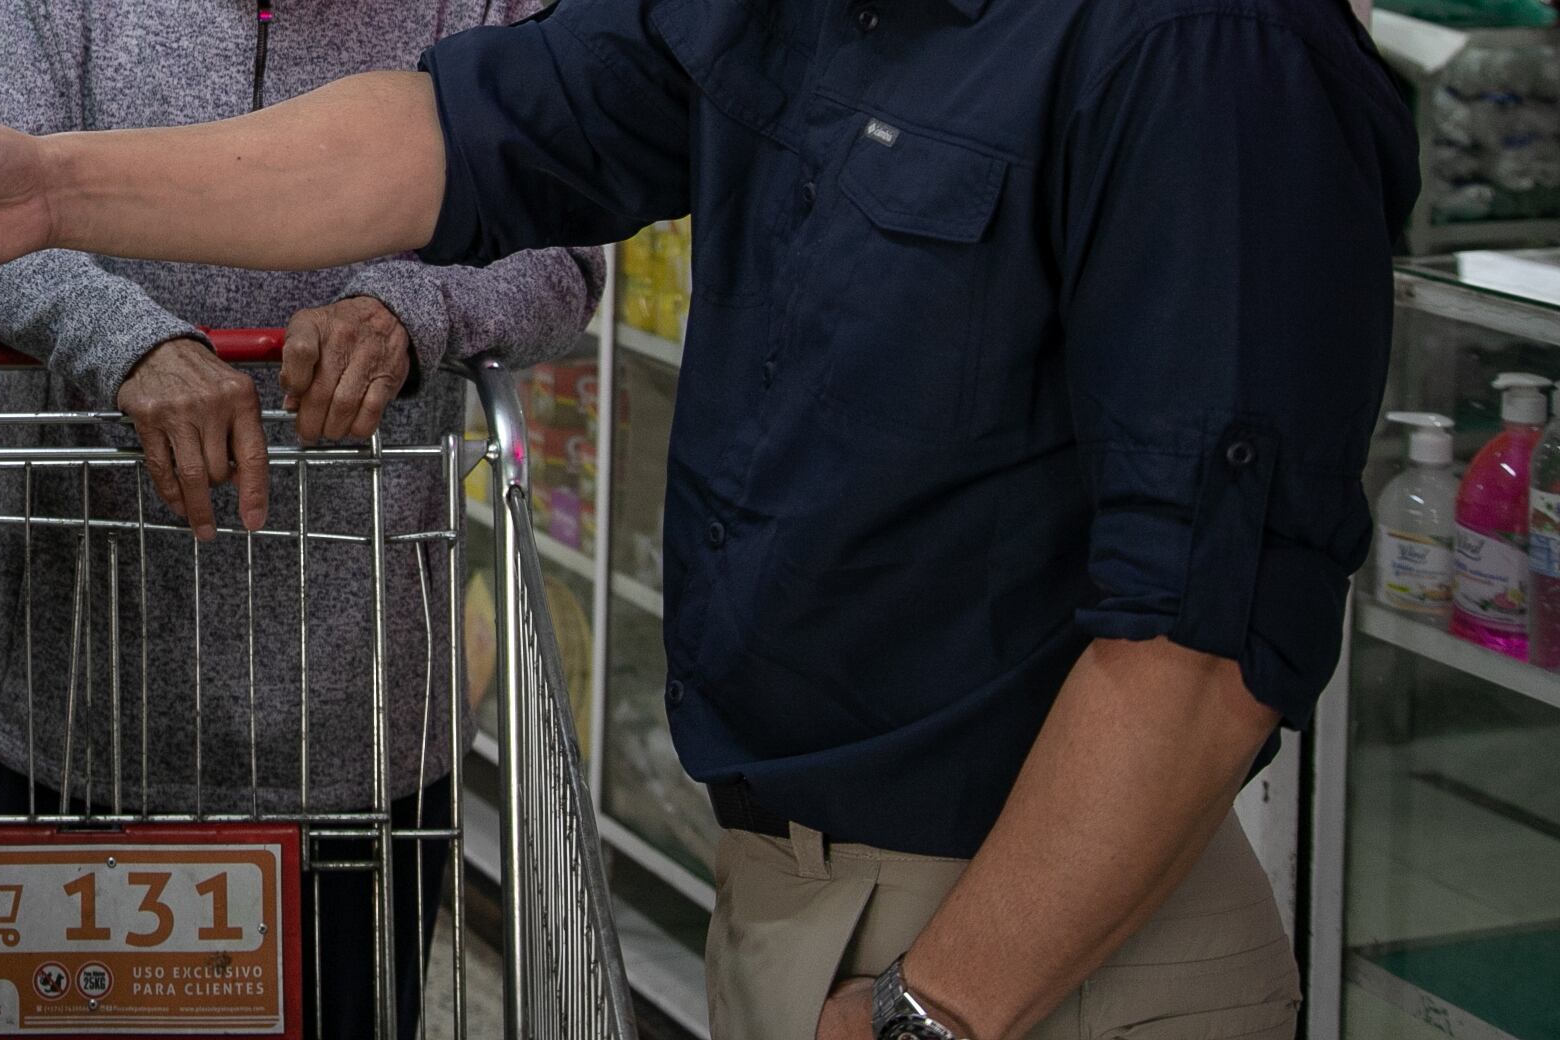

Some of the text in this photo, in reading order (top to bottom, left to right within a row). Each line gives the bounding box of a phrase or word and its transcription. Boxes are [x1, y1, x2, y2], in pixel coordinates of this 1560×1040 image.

[63, 871, 243, 947] 131
[133, 966, 264, 980] USO EXCLUSIVO
[83, 976, 106, 991] 25KG
[133, 981, 265, 996] PARA CLIENTES
